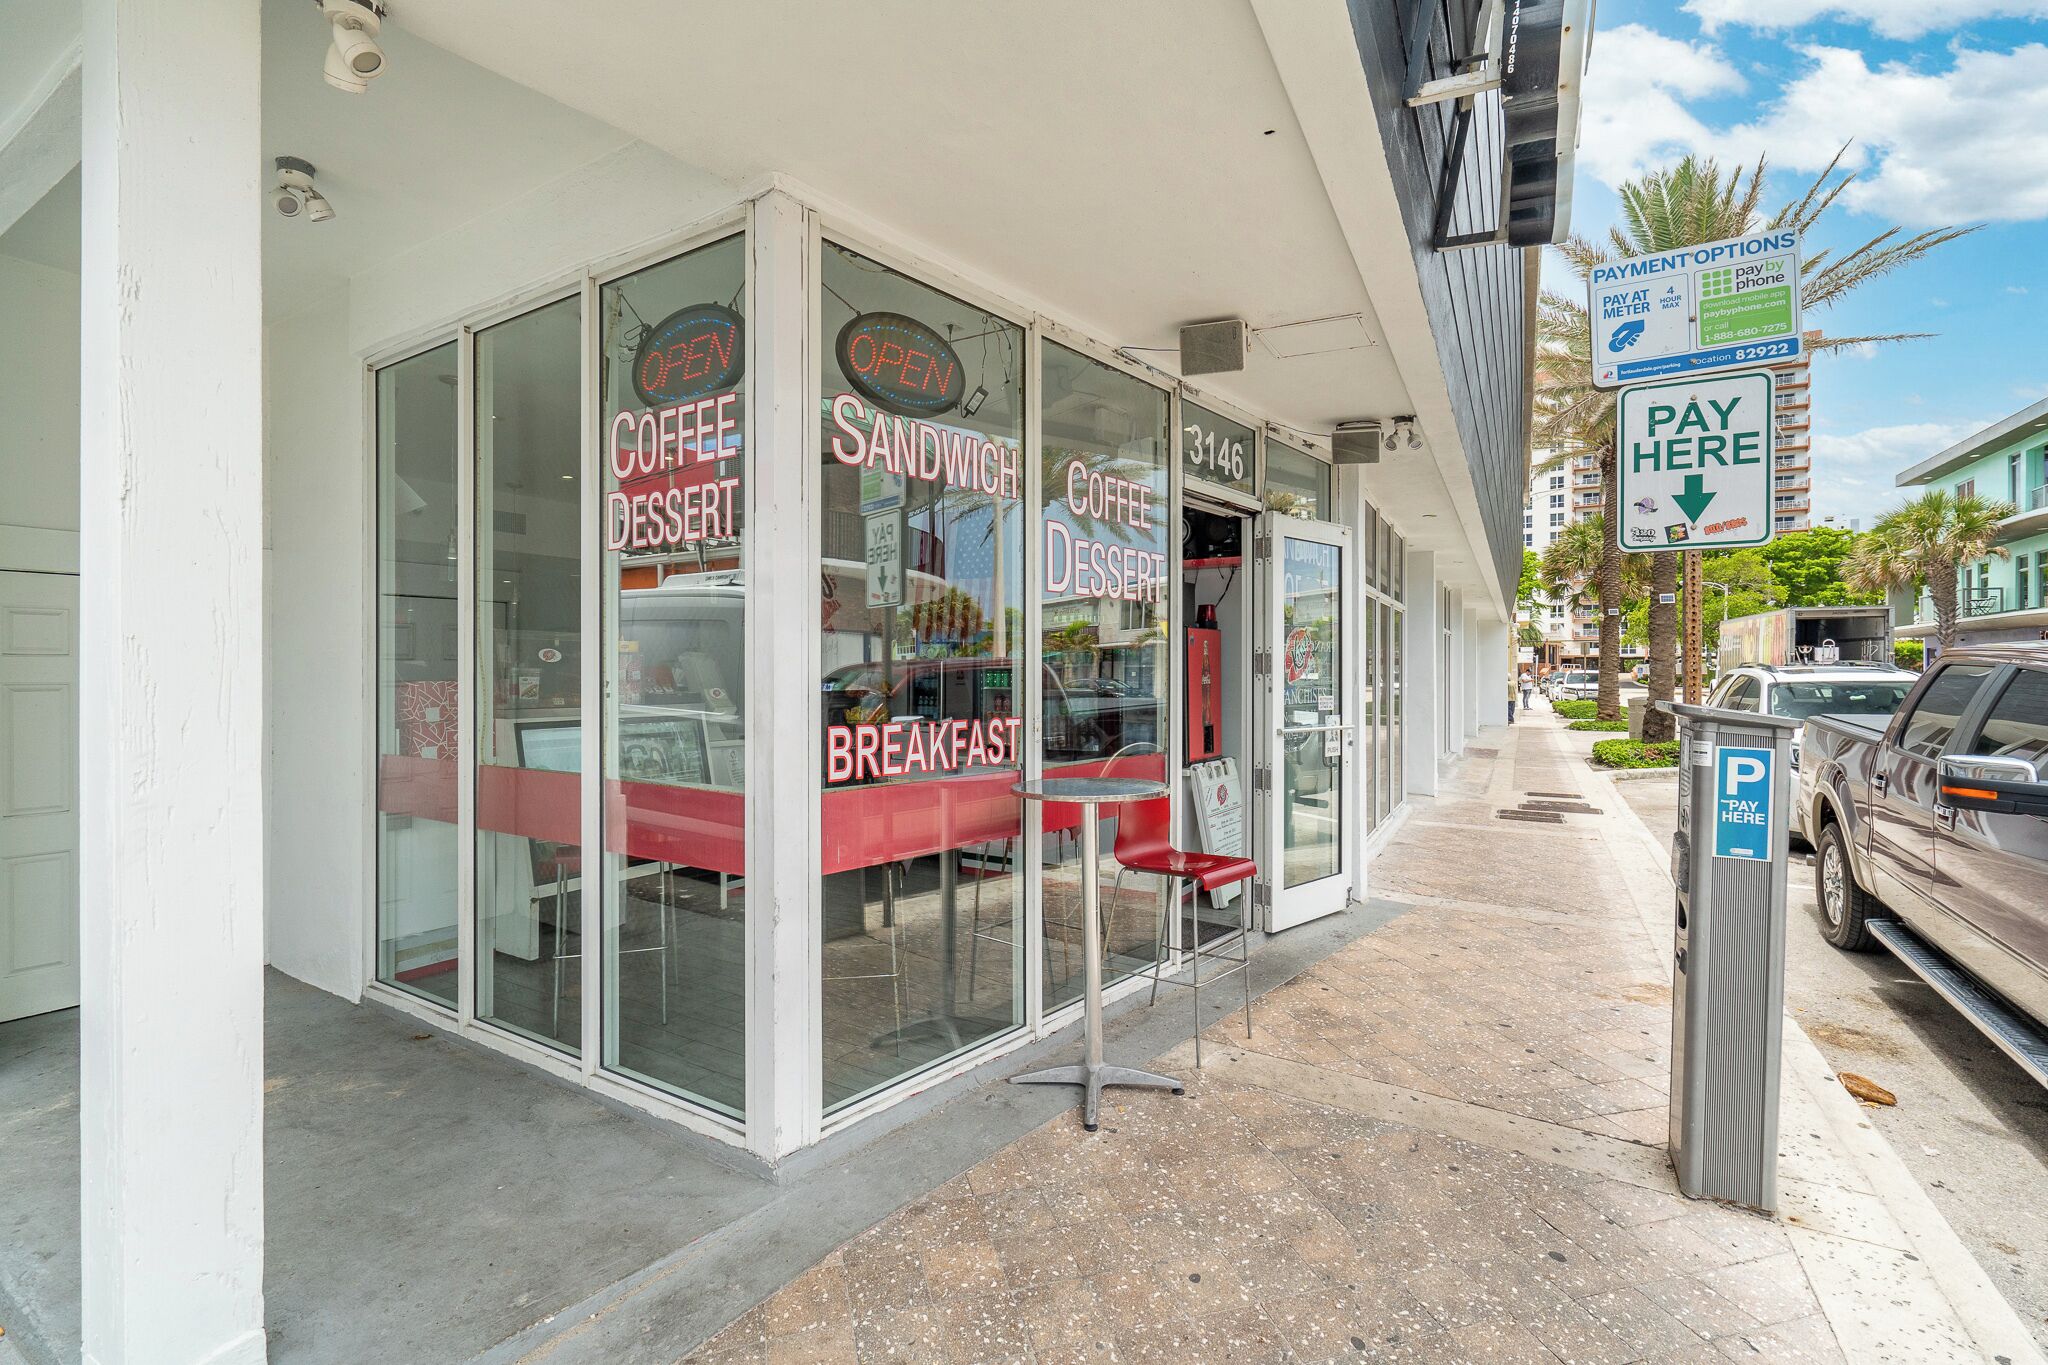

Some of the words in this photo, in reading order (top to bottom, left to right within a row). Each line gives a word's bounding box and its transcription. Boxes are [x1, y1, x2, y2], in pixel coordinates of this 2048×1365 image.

[1594, 253, 1690, 283] PAYMENT
[1694, 232, 1796, 264] OPTIONS
[1736, 264, 1764, 279] pay
[1765, 260, 1784, 272] by
[1666, 286, 1675, 295] 4
[1736, 274, 1785, 292] phone
[1603, 292, 1628, 307] PAY
[1631, 289, 1650, 302] AT
[1660, 295, 1682, 304] HOUR
[1662, 302, 1680, 310] MAX
[1703, 298, 1740, 309] download
[1741, 292, 1769, 303] mobile
[1603, 302, 1650, 319] METER
[1703, 300, 1786, 319] paybyphone.com
[1705, 322, 1787, 342] 1-888-680-7275
[1714, 322, 1729, 330] call
[641, 325, 736, 391] OPEN
[850, 334, 954, 395] OPEN
[1691, 354, 1731, 365] ocation
[1735, 343, 1789, 360] 82922
[1648, 396, 1742, 437] PAY
[609, 392, 736, 479] COFFEE
[832, 393, 1018, 499] SANDWICH
[1189, 424, 1244, 480] 3146
[1633, 431, 1760, 473] HERE
[1067, 460, 1151, 530] COFFEE
[607, 478, 739, 551] DESSERT
[1046, 519, 1165, 603] DESSERT
[828, 717, 1021, 783] BREAKFAST
[1726, 756, 1766, 795] P
[1729, 800, 1759, 812] PAY
[1722, 811, 1766, 825] HERE
